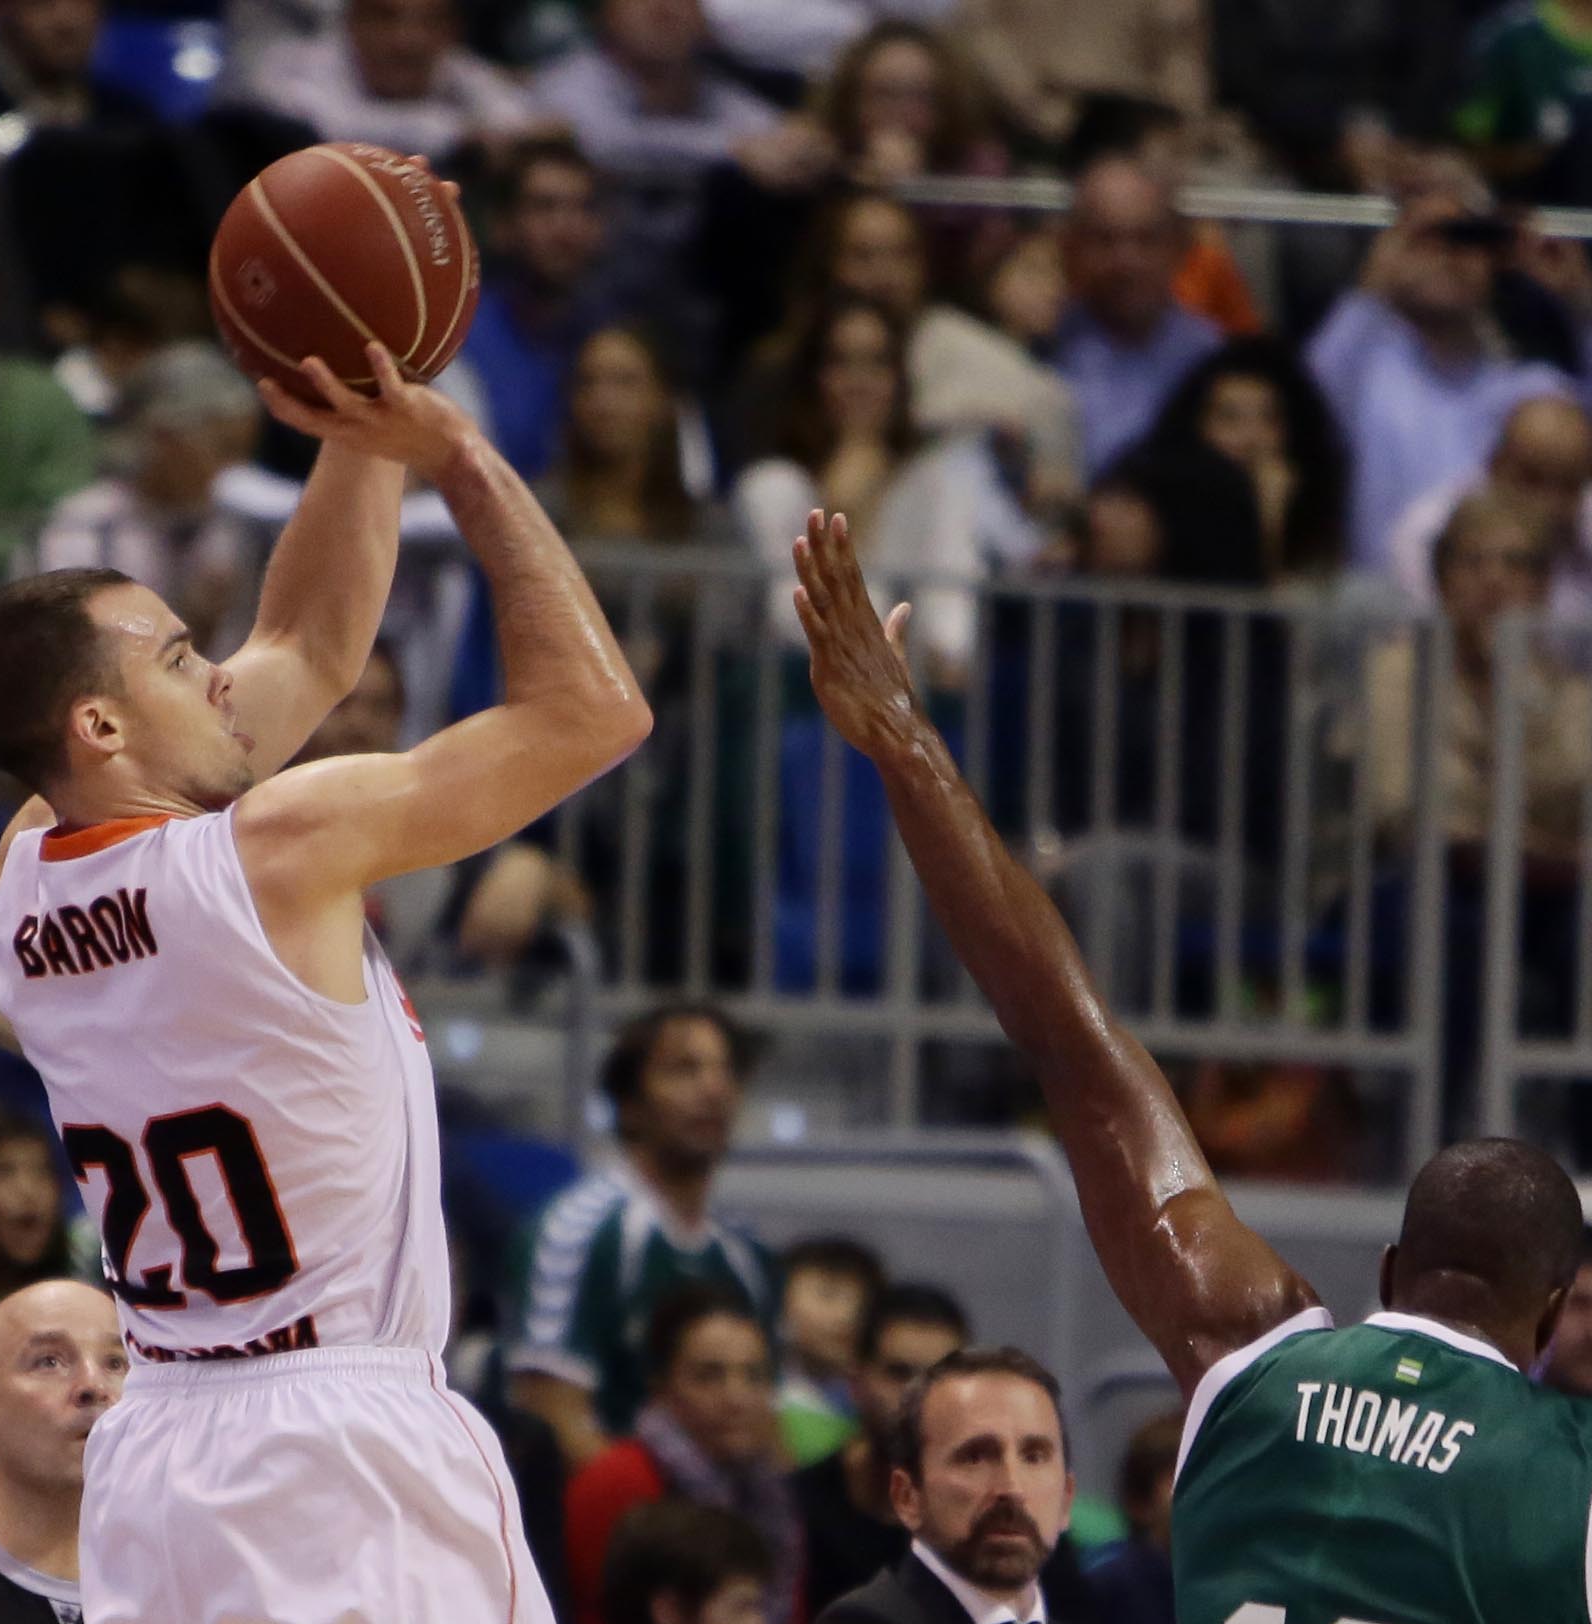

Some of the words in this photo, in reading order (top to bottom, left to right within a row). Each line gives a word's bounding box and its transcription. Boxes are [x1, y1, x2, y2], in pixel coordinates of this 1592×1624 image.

[13, 887, 159, 979] BARON
[62, 1102, 301, 1312] 20
[1295, 1382, 1476, 1474] THOMAS
